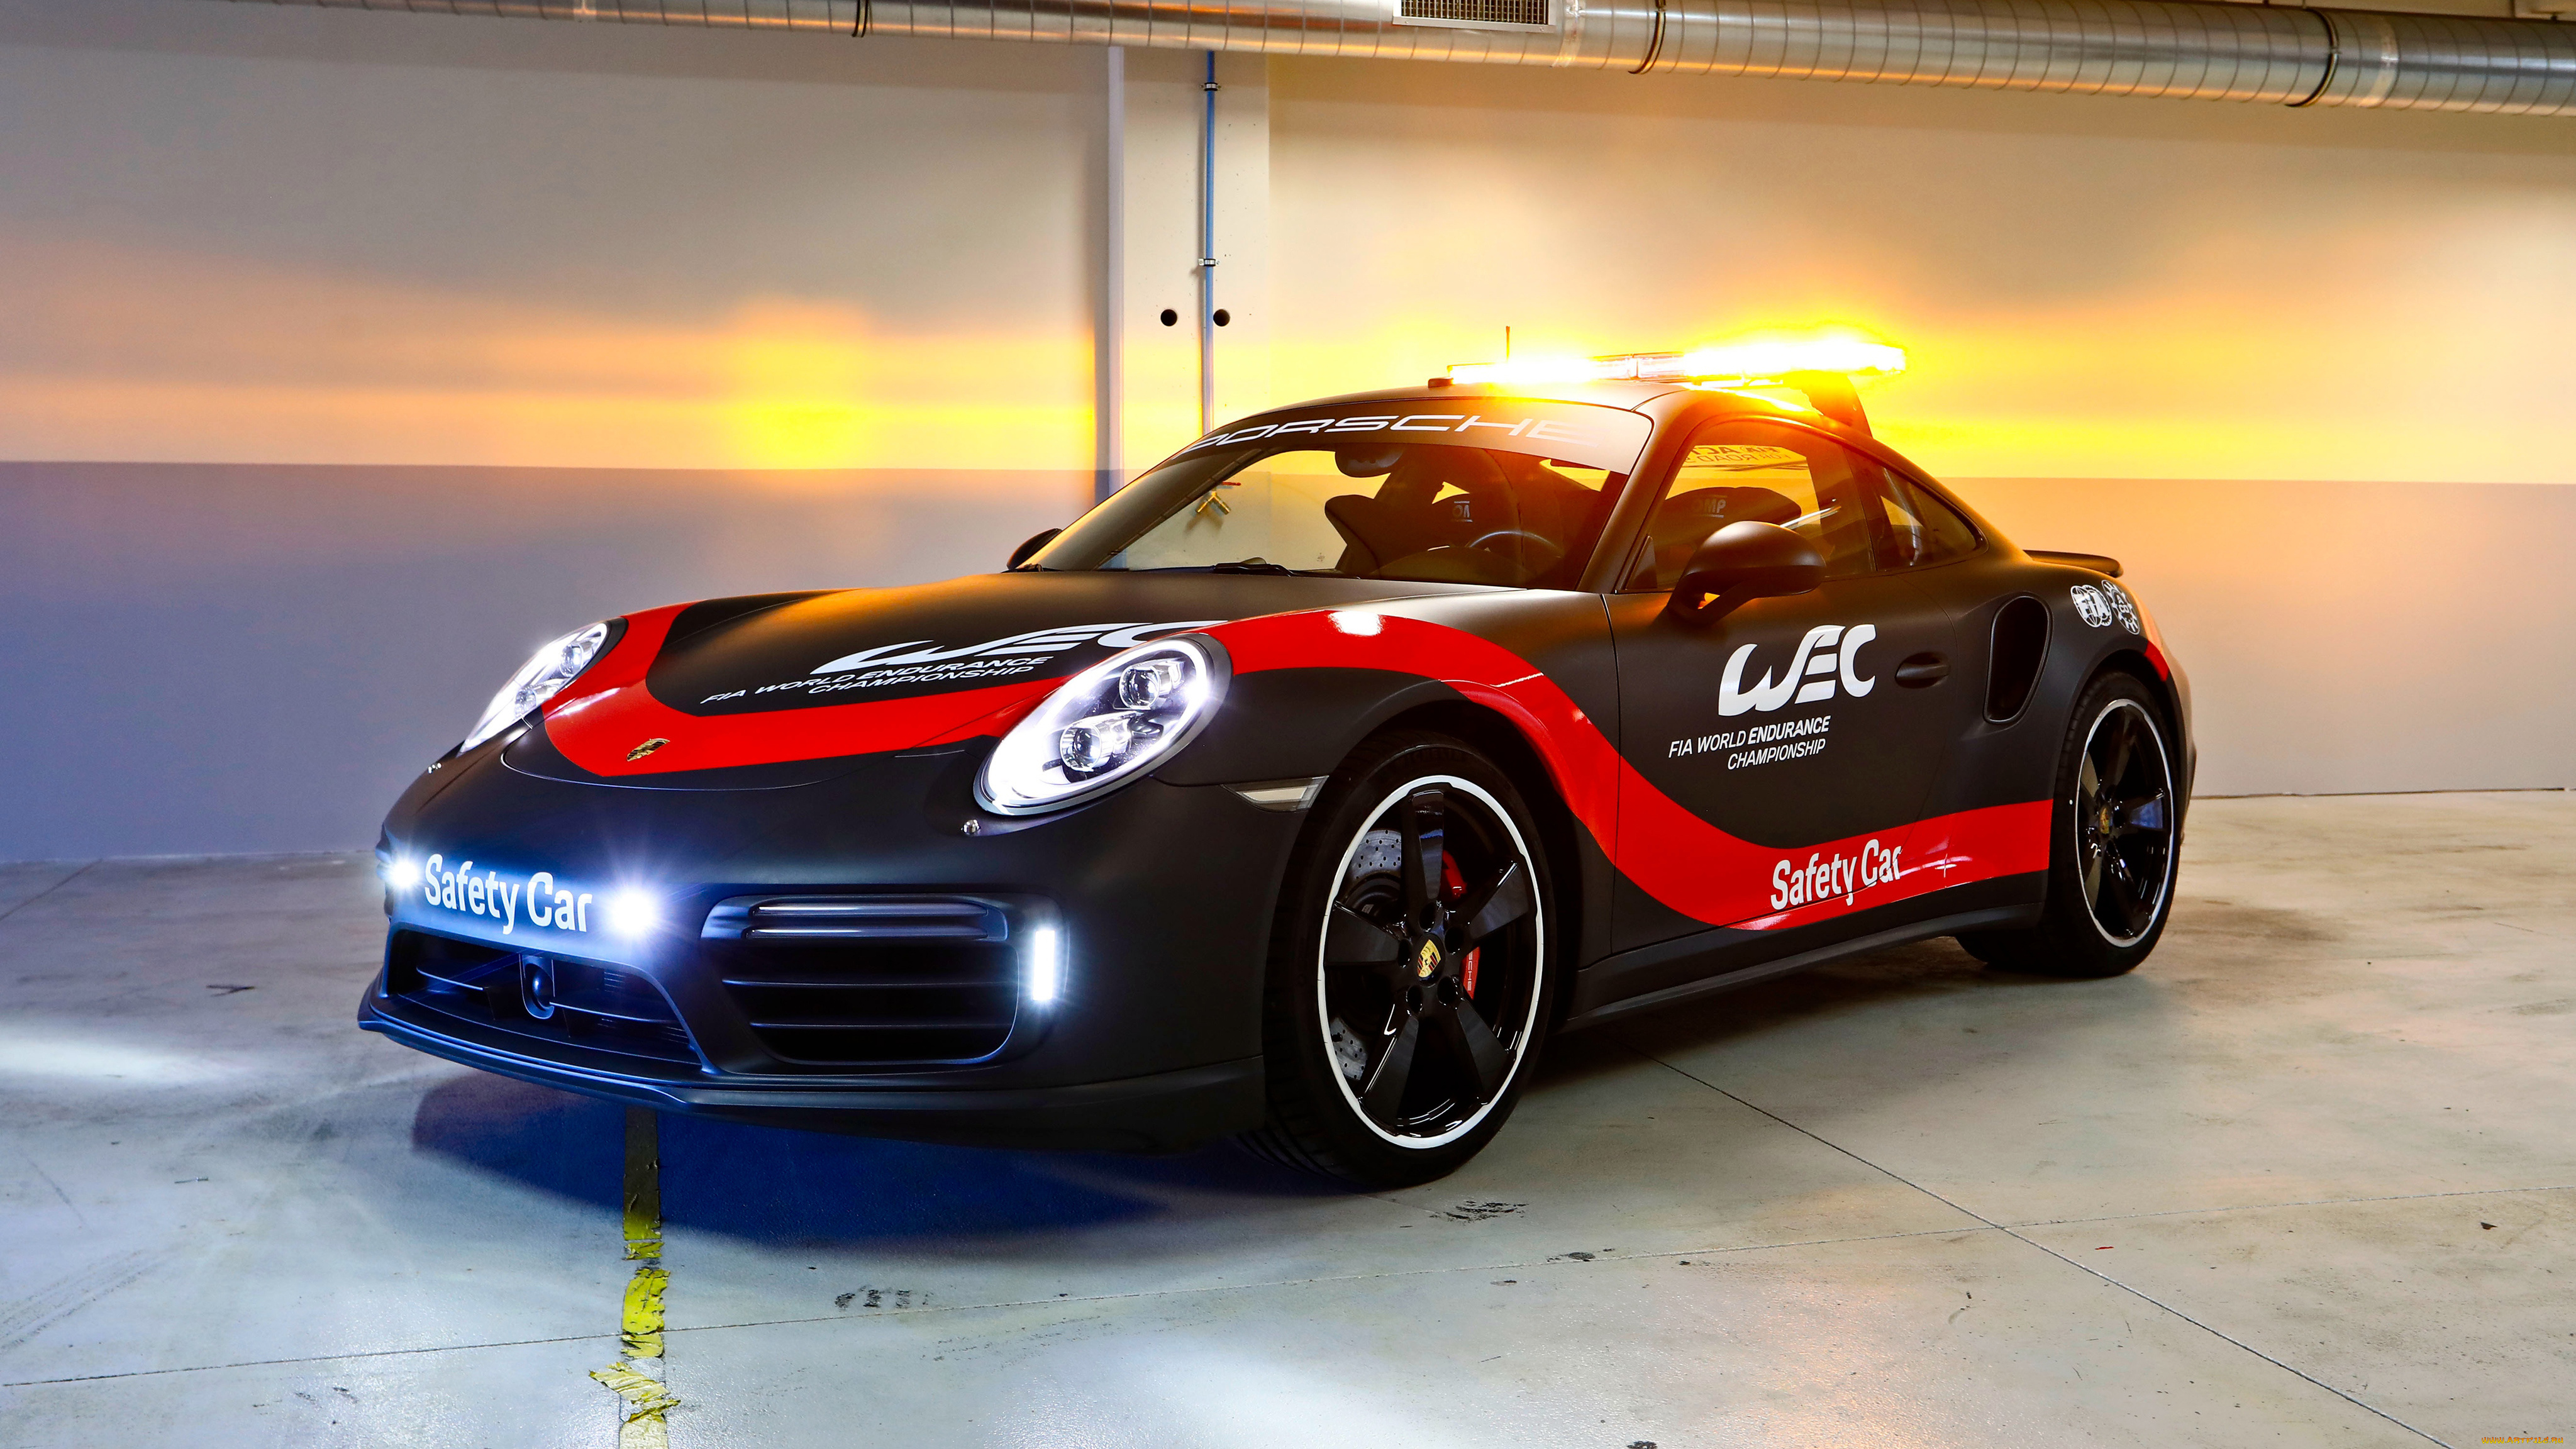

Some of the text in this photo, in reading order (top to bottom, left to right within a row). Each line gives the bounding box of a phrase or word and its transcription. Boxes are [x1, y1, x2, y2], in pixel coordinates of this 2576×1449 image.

[1171, 414, 1611, 460] PORSCHE
[2073, 593, 2110, 618] FIA
[809, 620, 1228, 675] WEC
[1718, 624, 1876, 716] WEC
[700, 656, 1054, 704] FIA WORLD ENDURANCE
[808, 666, 1034, 694] CHAMPIONSHIP
[1668, 716, 1831, 758] FIA WORLD ENDURANCE
[1727, 738, 1826, 770] CHAMPIONSHIP
[425, 853, 592, 935] Safety Car
[1770, 839, 1901, 910] Safety Car
